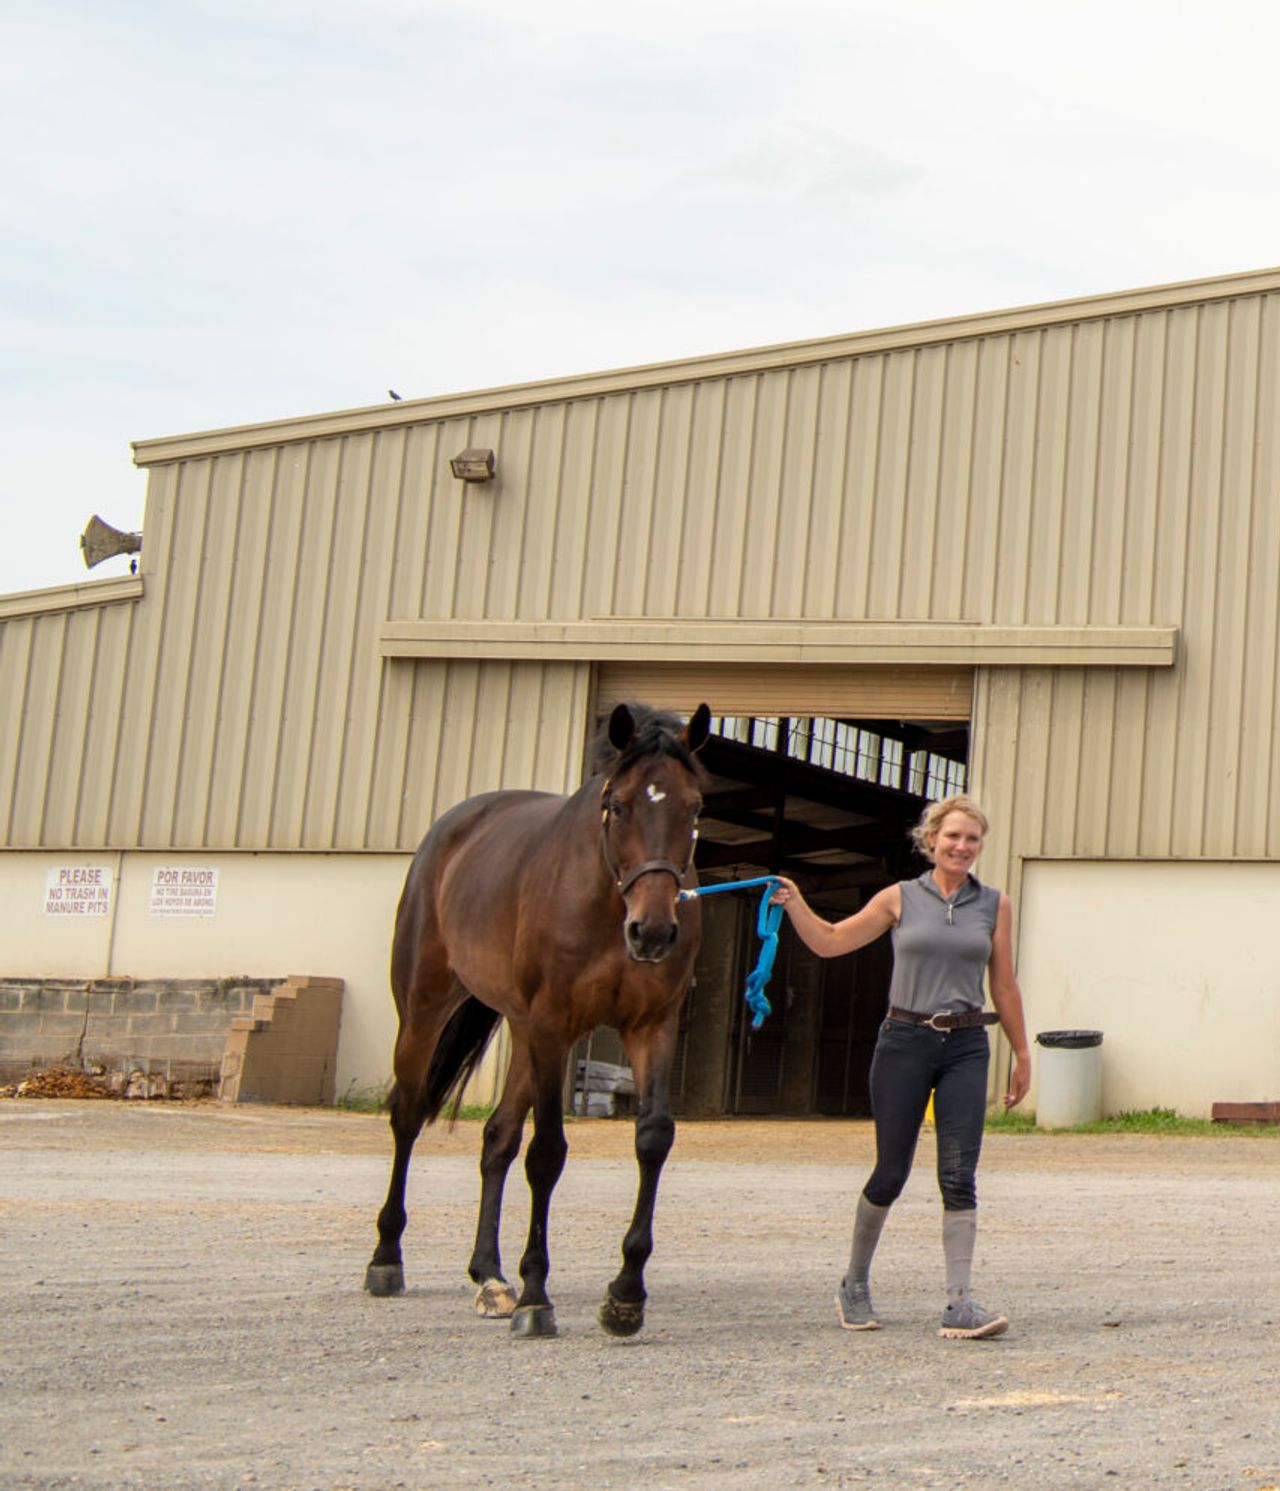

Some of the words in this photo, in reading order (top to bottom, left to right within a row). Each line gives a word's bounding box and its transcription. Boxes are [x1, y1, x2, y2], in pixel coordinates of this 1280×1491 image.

[60, 869, 101, 883] PLEASE
[157, 871, 179, 883] POR
[181, 871, 213, 884] FAVOR
[49, 888, 63, 900] NO
[65, 888, 96, 900] TRASH
[98, 888, 109, 899] IN
[47, 901, 85, 913] MANURE
[87, 901, 108, 913] PITS
